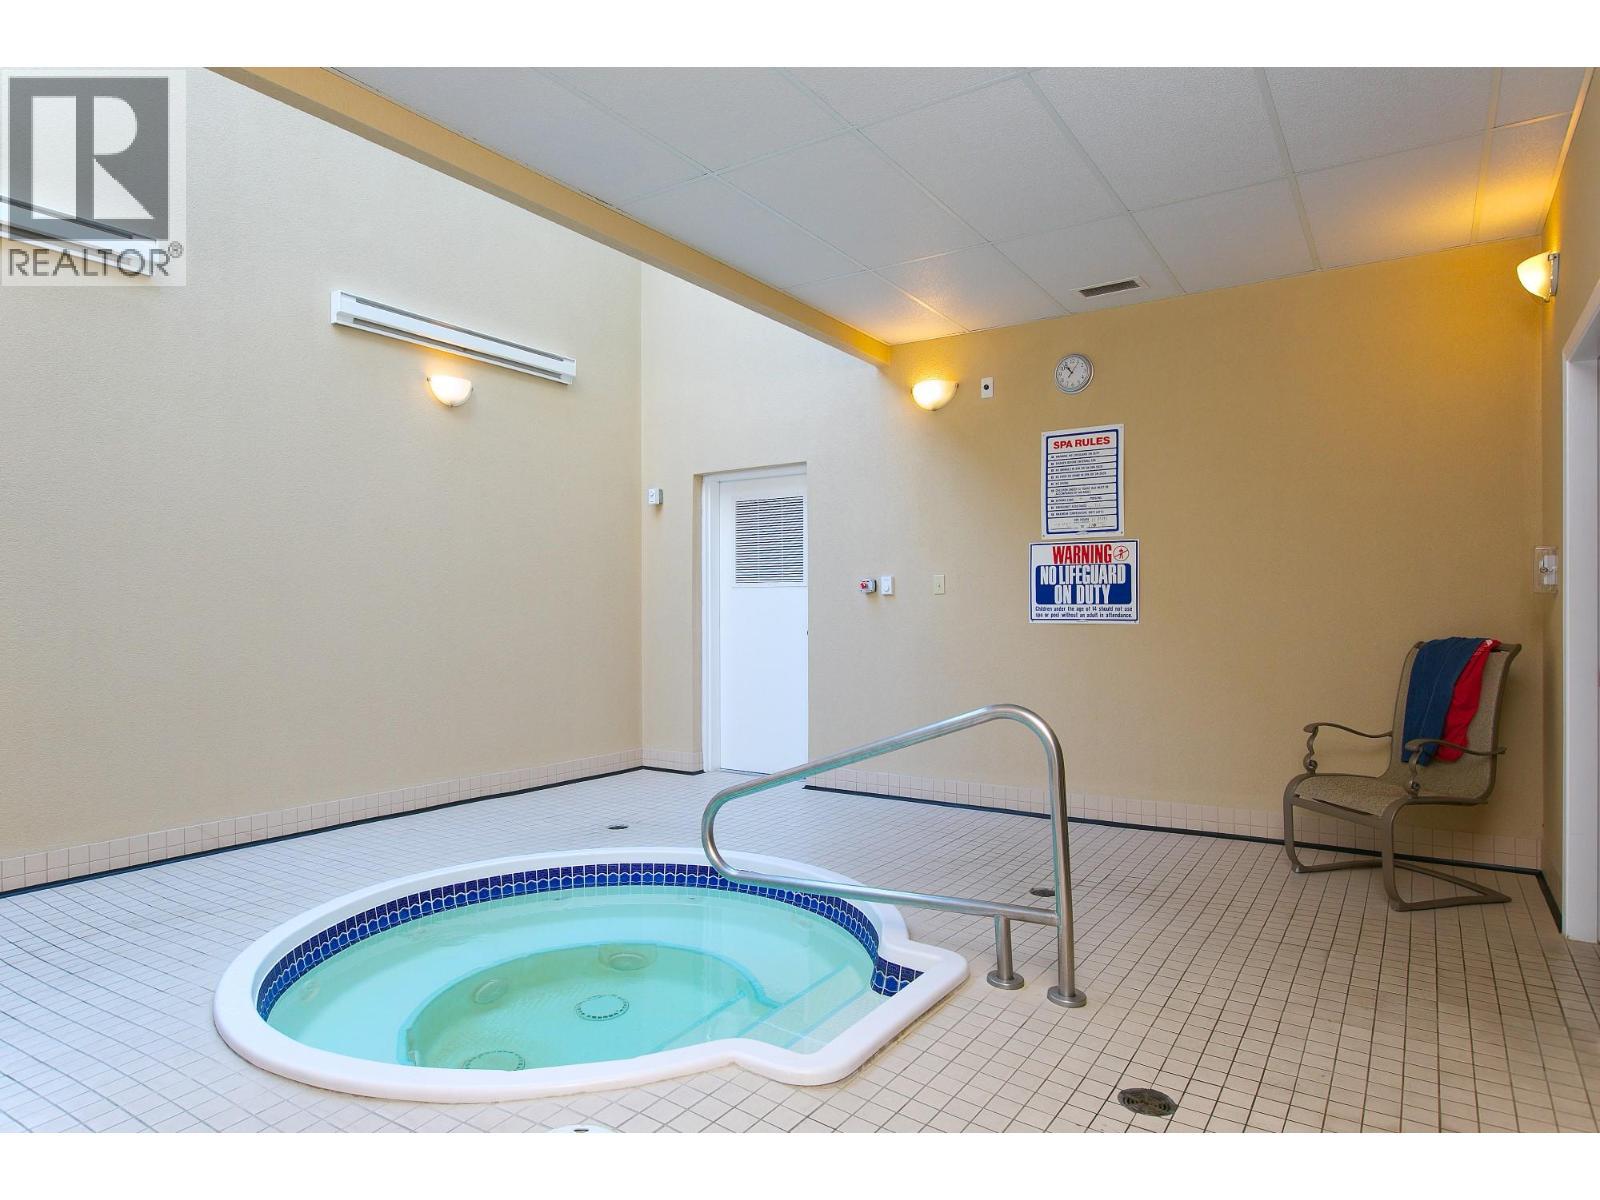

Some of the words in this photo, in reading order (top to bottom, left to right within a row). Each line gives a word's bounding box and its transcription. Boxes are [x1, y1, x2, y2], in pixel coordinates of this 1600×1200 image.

[1053, 440, 1073, 449] SPA
[1075, 436, 1110, 448] RULES
[1053, 544, 1112, 564] WARNING
[1040, 565, 1057, 585] NO
[1058, 564, 1126, 585] LIFEGUARD
[1054, 584, 1071, 604] ON
[1076, 584, 1111, 604] DUTY
